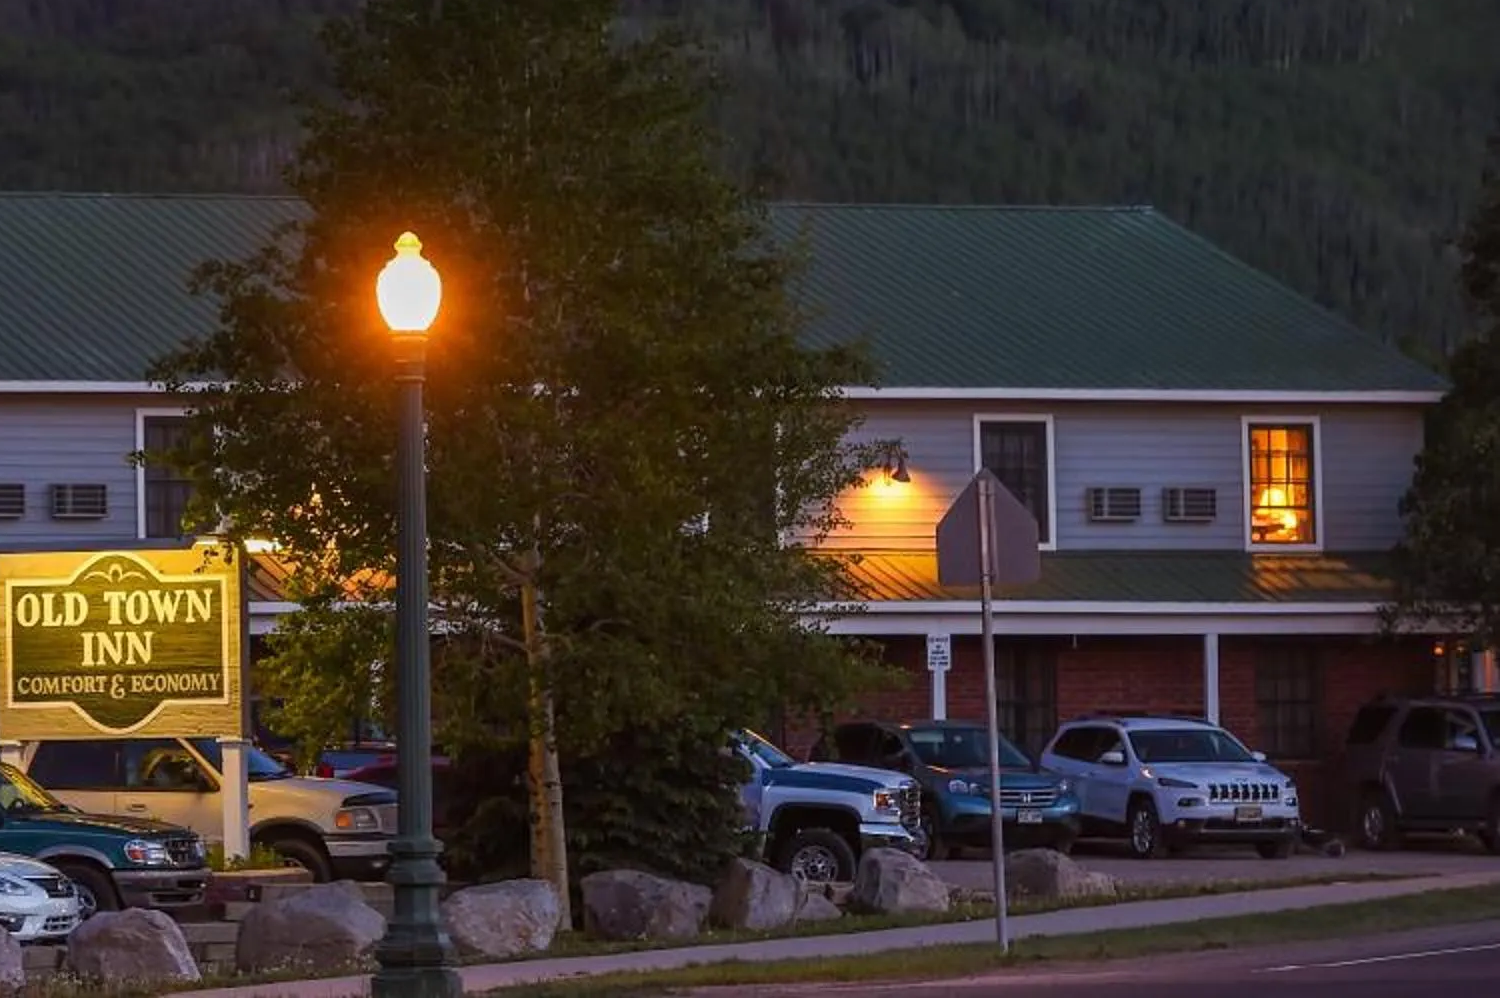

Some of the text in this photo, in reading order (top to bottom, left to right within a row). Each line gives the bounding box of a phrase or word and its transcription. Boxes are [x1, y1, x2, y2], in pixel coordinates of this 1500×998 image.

[16, 588, 213, 627] OLD TOWN
[81, 631, 154, 667] INN
[17, 673, 221, 700] COMFORT & ECONOMY
